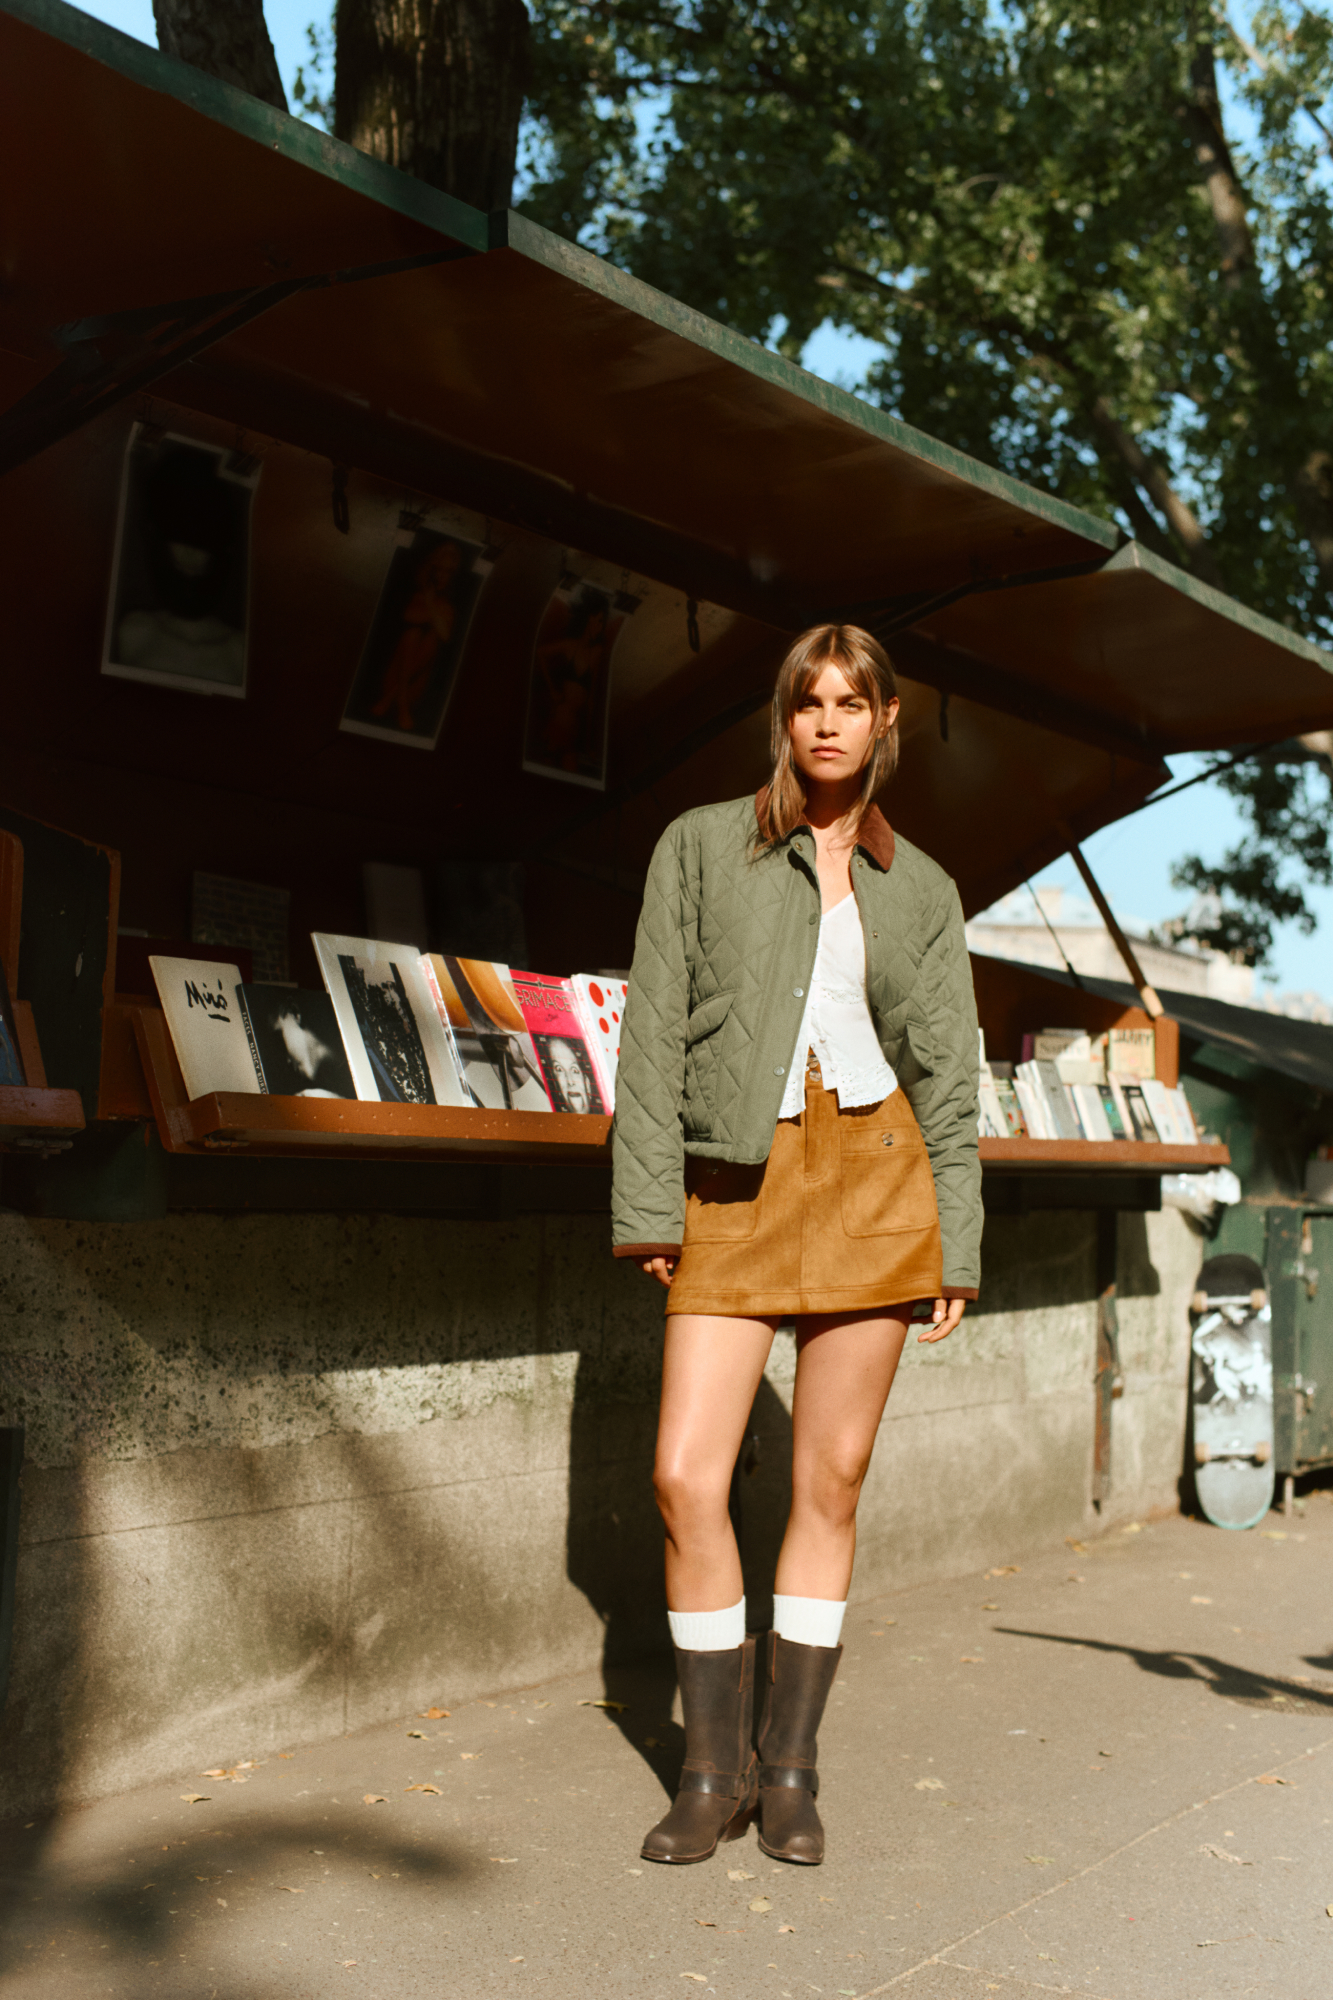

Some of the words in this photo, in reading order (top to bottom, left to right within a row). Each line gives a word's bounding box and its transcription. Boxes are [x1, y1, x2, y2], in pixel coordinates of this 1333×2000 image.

[184, 978, 228, 1010] Miró
[242, 1012, 252, 1035] FACES
[250, 1042, 260, 1070] NANCY
